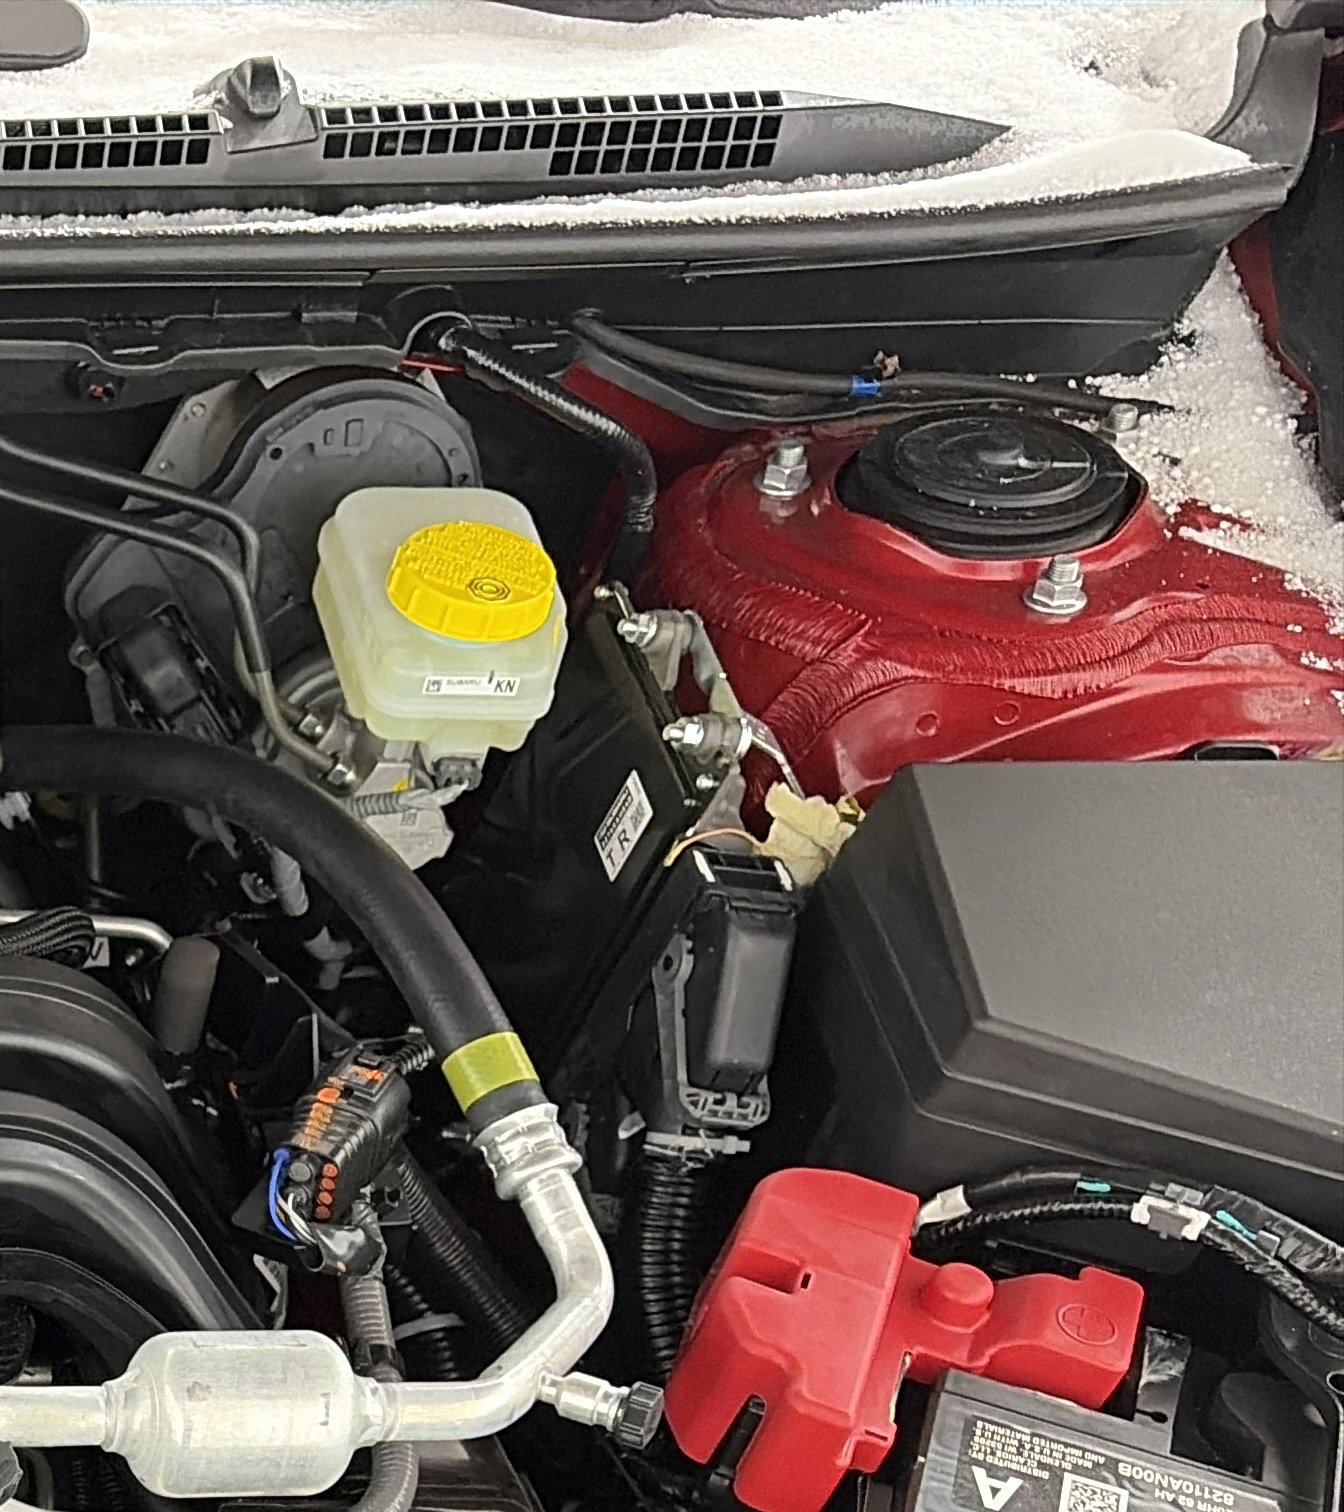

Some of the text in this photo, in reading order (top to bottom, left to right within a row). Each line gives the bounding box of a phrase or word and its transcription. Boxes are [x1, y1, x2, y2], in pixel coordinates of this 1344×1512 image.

[493, 679, 516, 693] KN
[976, 1420, 1032, 1441] MATERIALS
[993, 1433, 1019, 1447] WITH
[1032, 1436, 1083, 1456] IMPORTED
[1003, 1441, 1018, 1454] WI
[1052, 1451, 1064, 1460] IN
[1066, 1455, 1093, 1469] MADE
[985, 1453, 1050, 1480] DISTRIBUTED
[1117, 1462, 1235, 1501] 82110AN00B
[1154, 1488, 1175, 1502] AH
